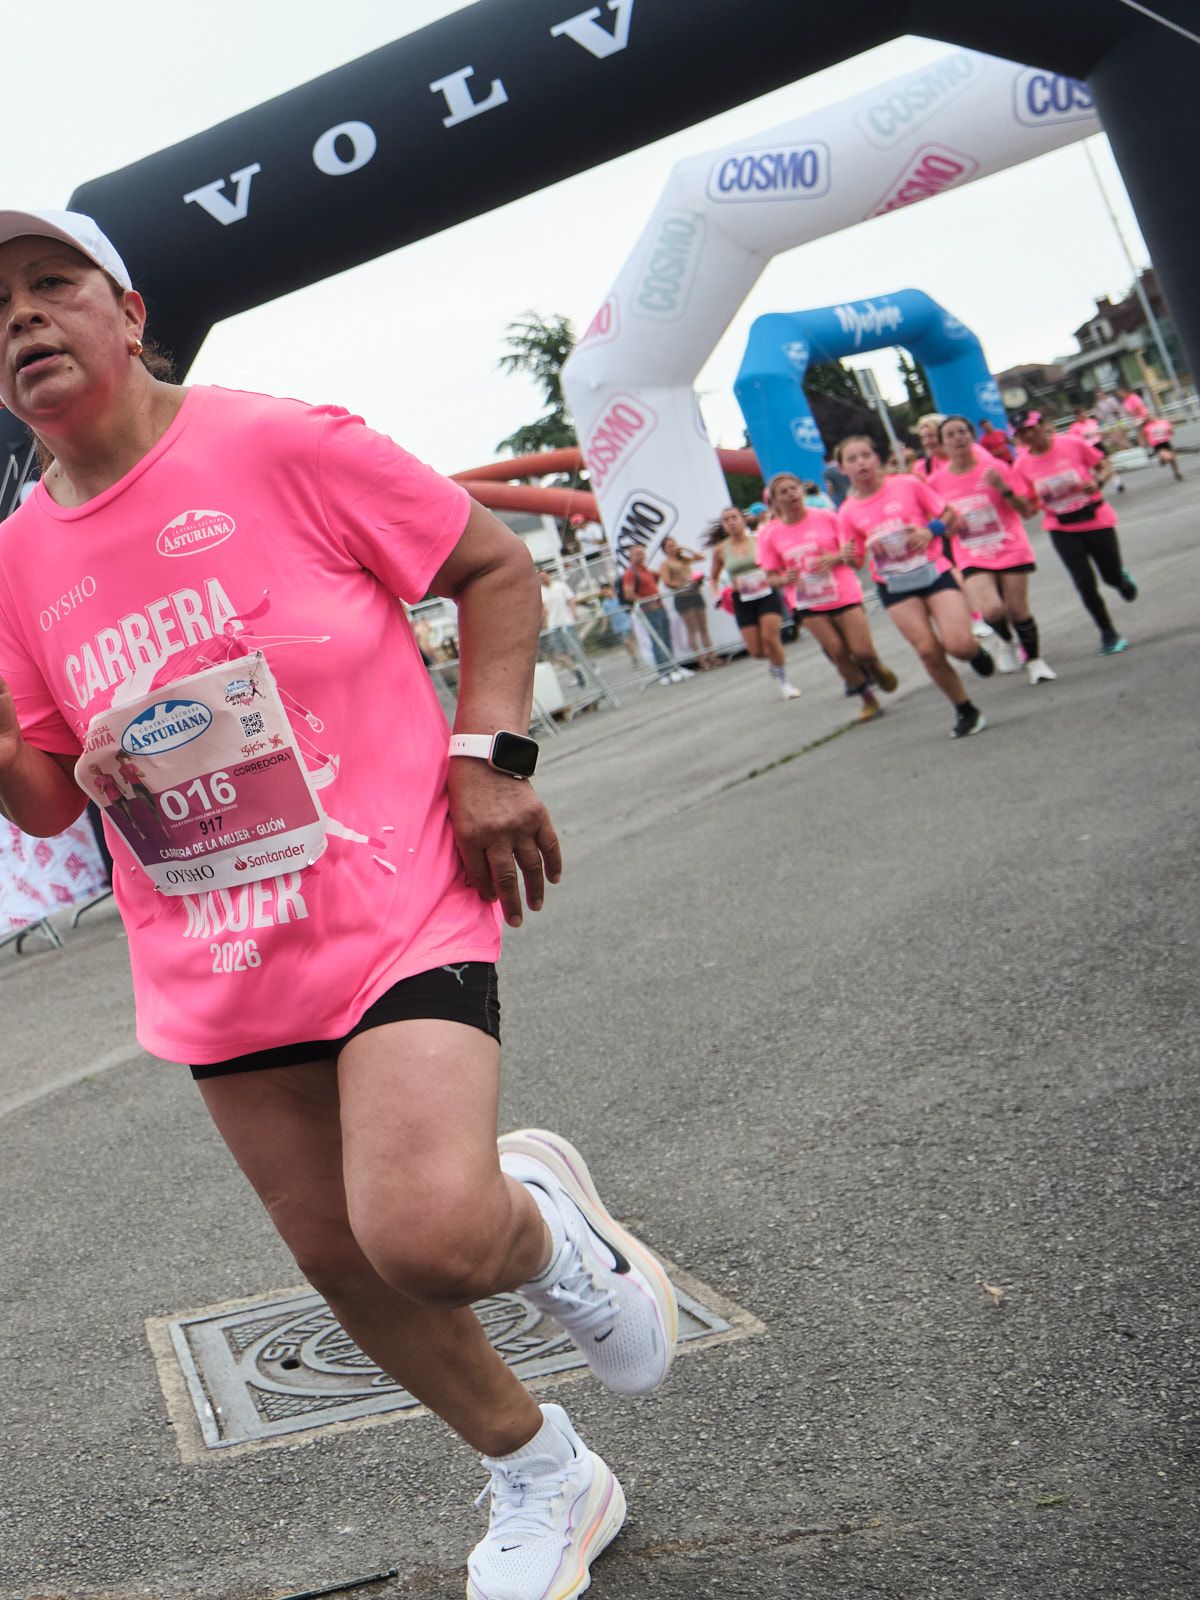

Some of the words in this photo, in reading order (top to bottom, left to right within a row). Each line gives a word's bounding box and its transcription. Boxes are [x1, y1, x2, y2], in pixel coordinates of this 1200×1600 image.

[183, 0, 635, 227] VOLV
[1026, 73, 1094, 116] COS
[717, 149, 819, 193] COSMO
[638, 217, 696, 311] COSMO
[164, 522, 231, 553] ASTURIANA
[39, 575, 97, 632] OYSHO
[64, 577, 245, 710] CARRERA
[130, 713, 208, 752] ASTURIANA
[233, 753, 292, 777] CORREDORA
[159, 771, 238, 822] 016
[193, 843, 205, 855] DE
[205, 839, 218, 850] LA
[218, 829, 250, 847] MUJER
[256, 817, 287, 835] GIJÓN
[200, 816, 222, 835] 917
[166, 864, 215, 884] OYSHO
[247, 843, 305, 868] Santander
[210, 939, 262, 973] 2026
